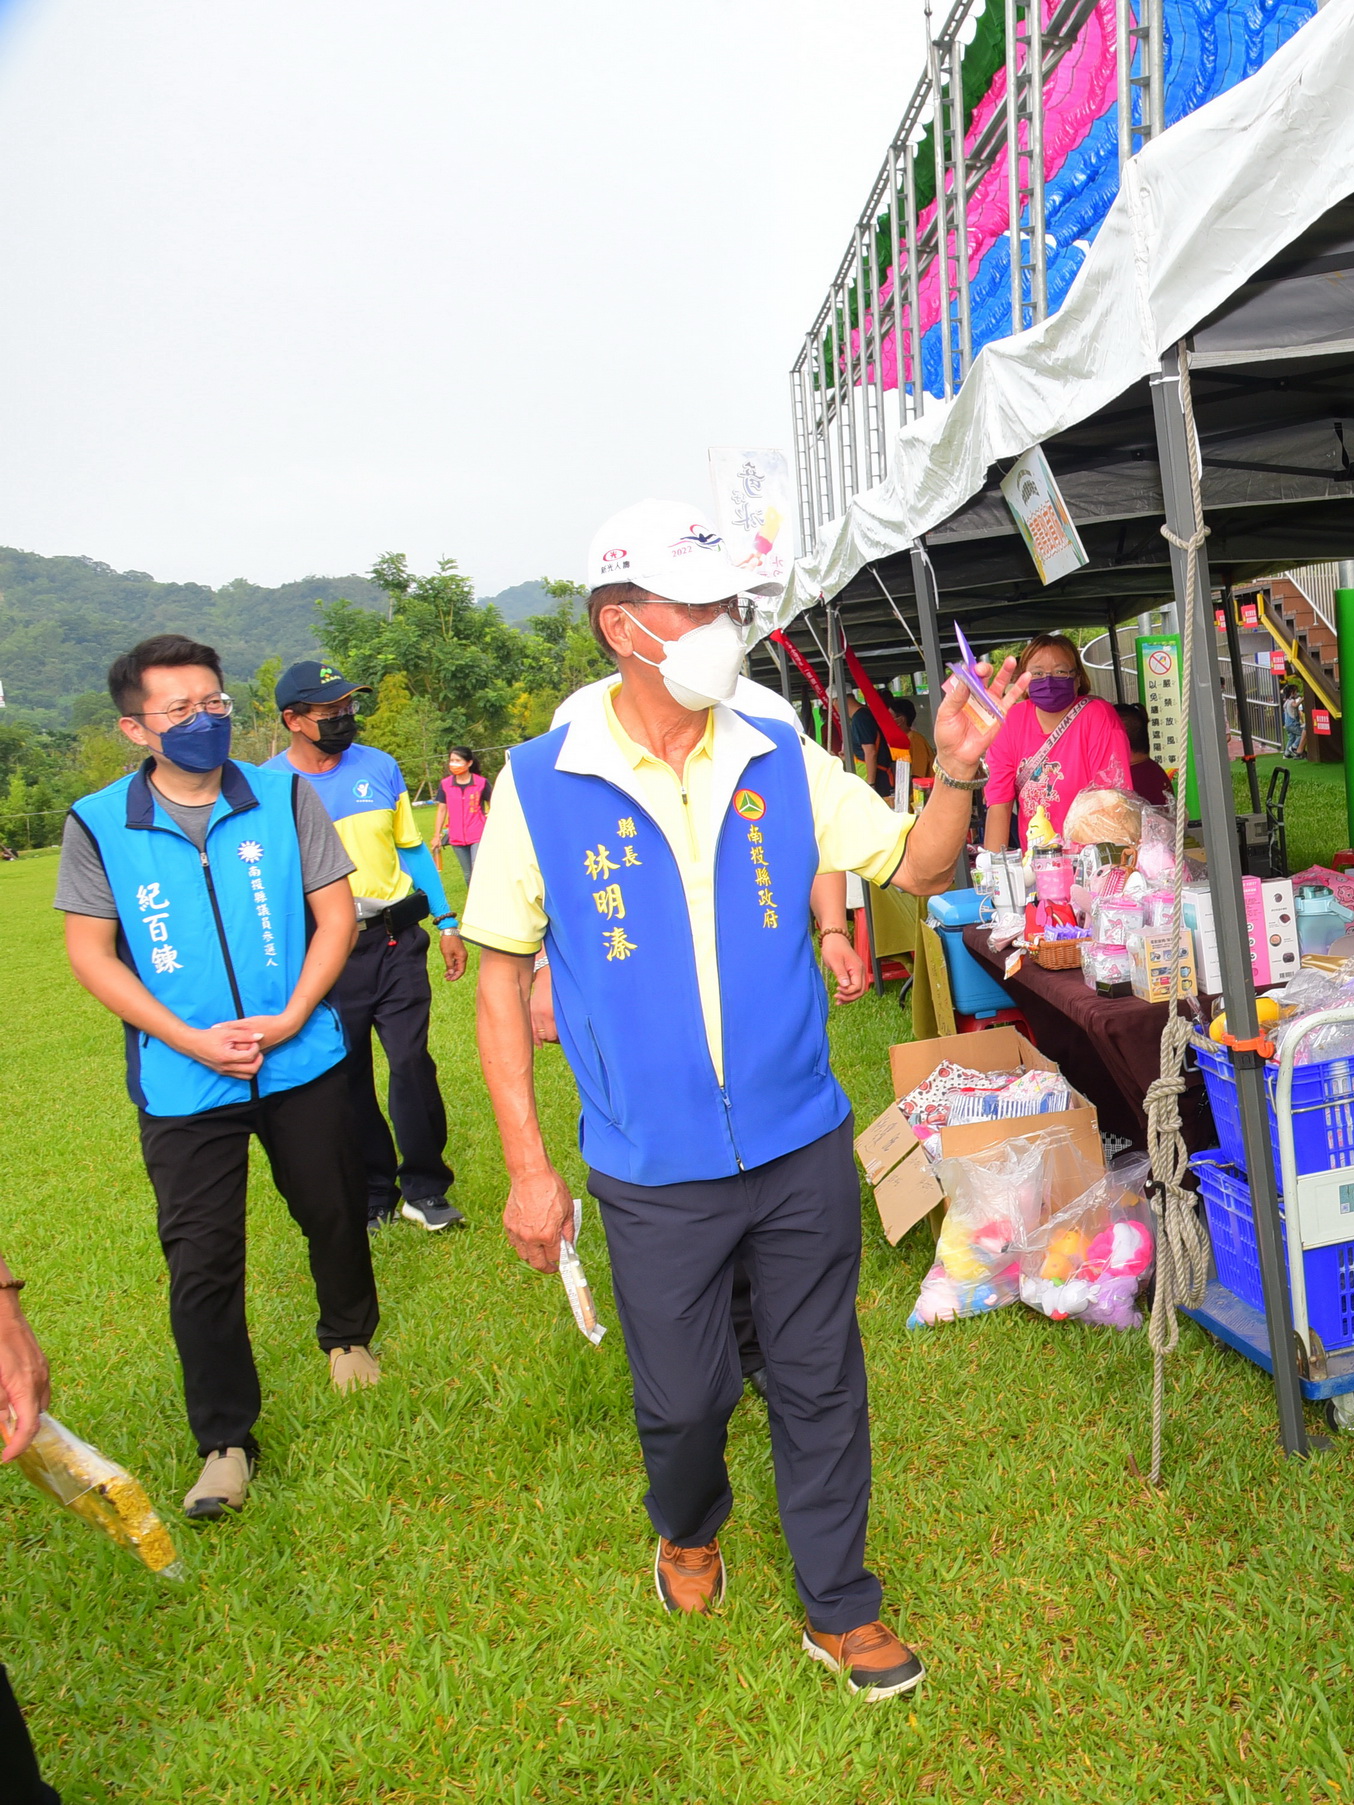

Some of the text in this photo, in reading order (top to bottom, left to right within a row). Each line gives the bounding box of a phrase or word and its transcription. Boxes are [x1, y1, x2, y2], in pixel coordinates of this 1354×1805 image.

[671, 545, 692, 558] 2022
[1046, 697, 1088, 749] OFF-WHITE
[616, 816, 643, 867] 縣長
[747, 824, 778, 929] 南投縣政府
[584, 844, 639, 962] 林明溱
